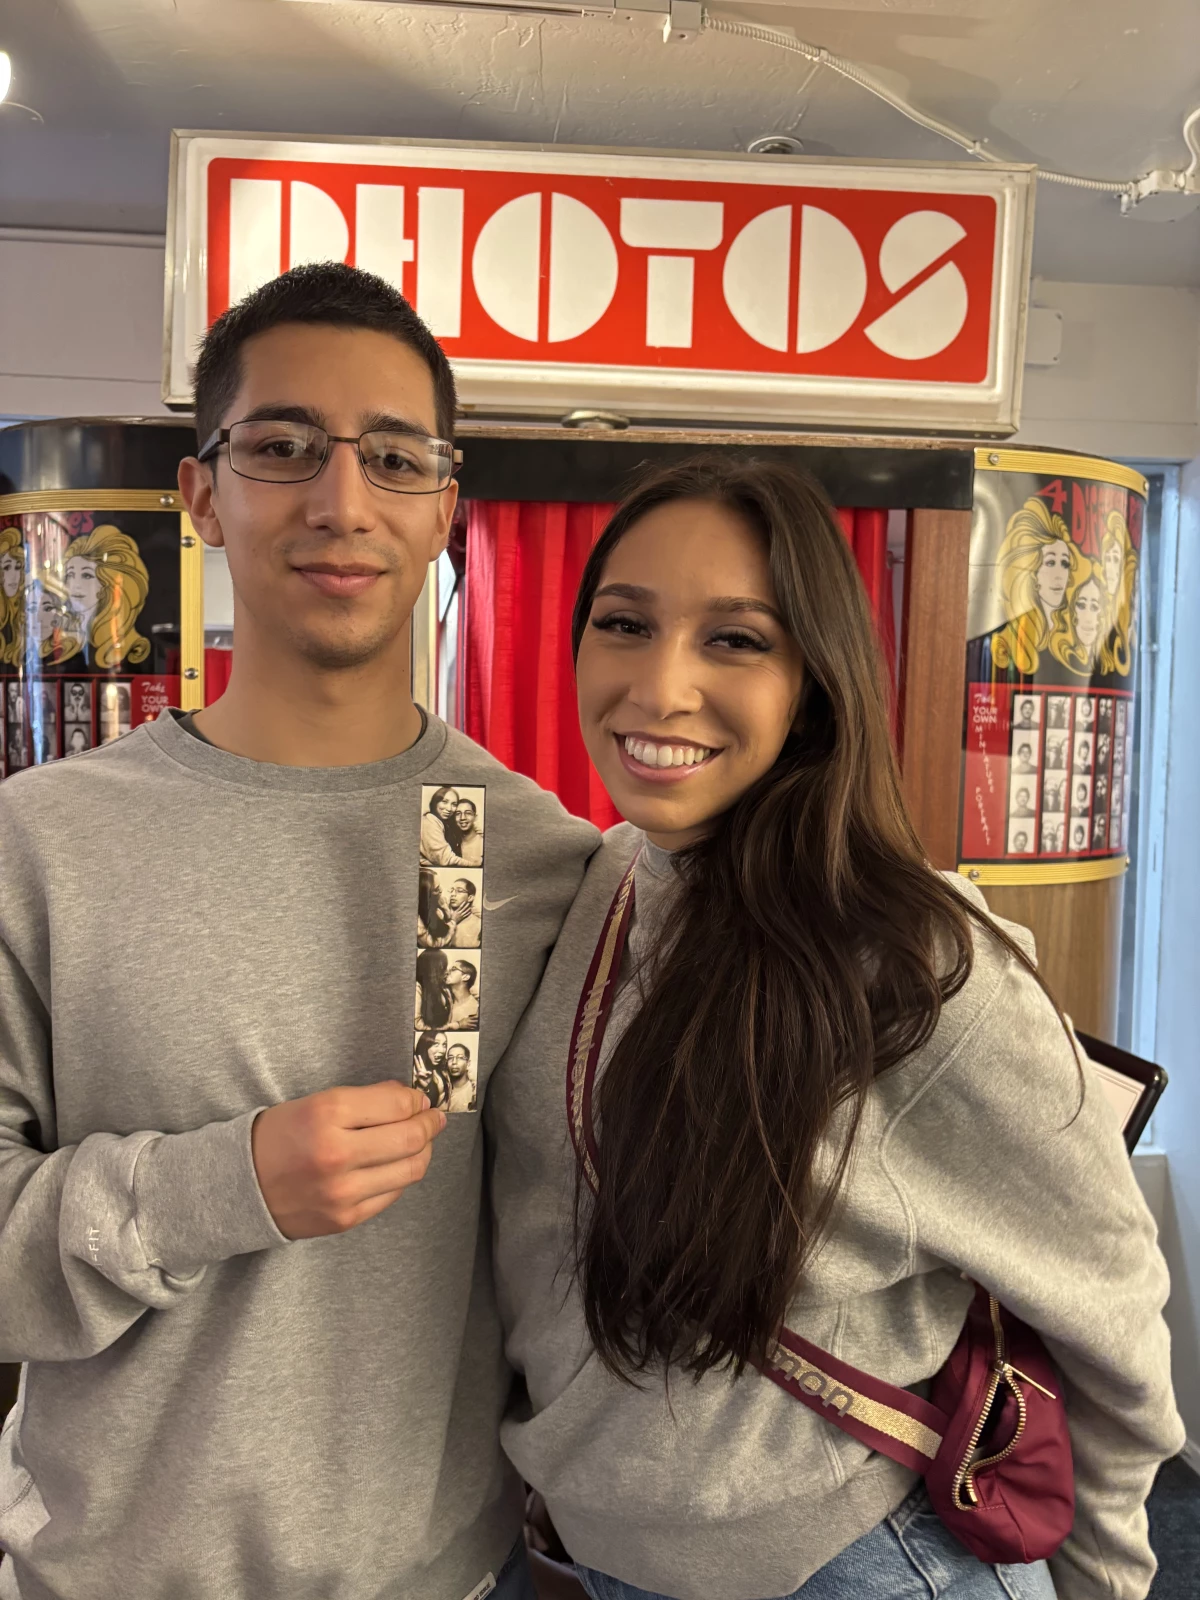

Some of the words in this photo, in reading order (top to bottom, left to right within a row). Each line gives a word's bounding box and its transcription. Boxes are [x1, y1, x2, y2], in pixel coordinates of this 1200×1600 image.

[229, 177, 969, 361] PHOTOS
[141, 696, 169, 705] YOUR
[973, 706, 998, 715] YOUR
[973, 715, 997, 723] OWN
